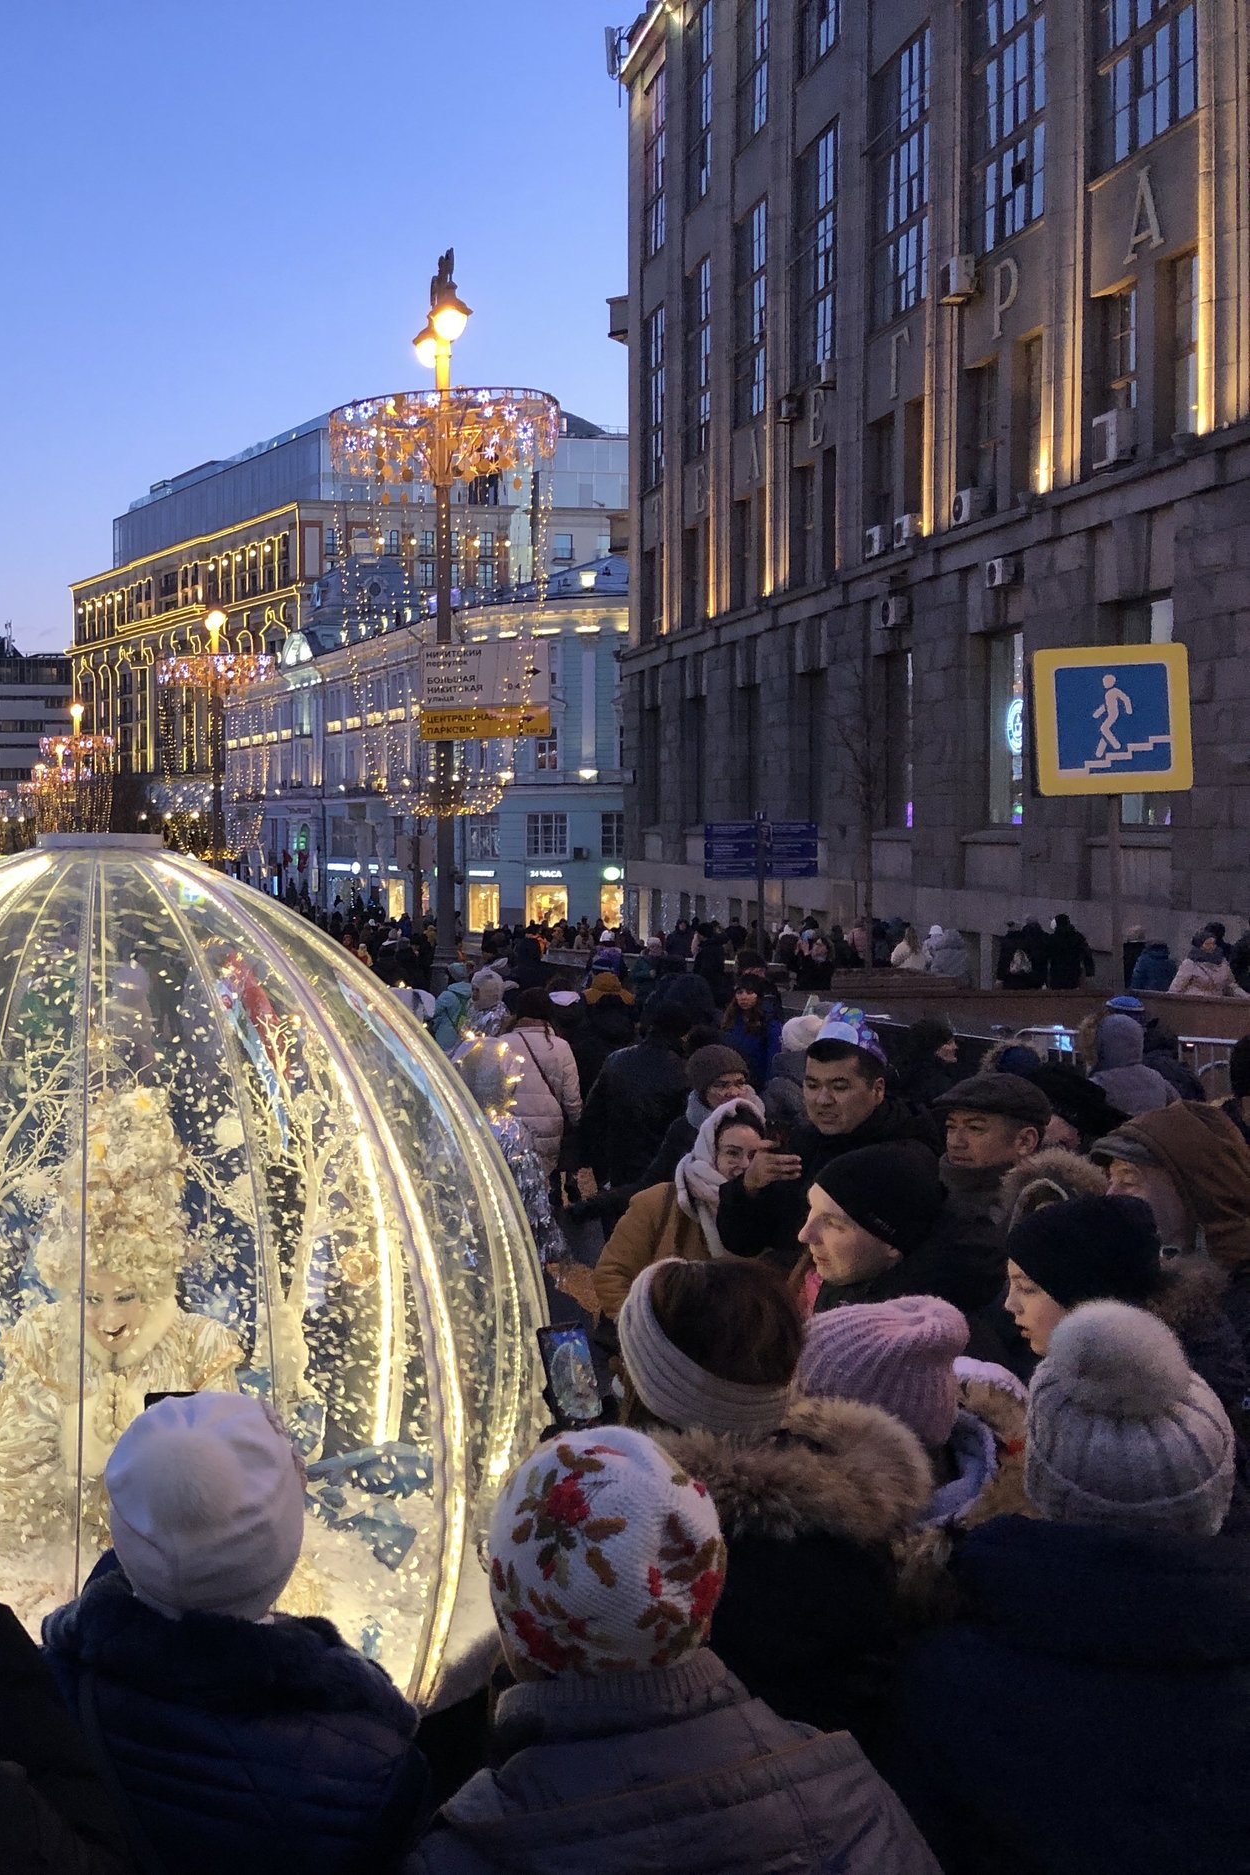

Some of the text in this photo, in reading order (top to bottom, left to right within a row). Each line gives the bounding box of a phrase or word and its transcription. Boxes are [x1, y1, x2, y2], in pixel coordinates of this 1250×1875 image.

[427, 675, 476, 685] БОЛЬШАЯ
[427, 684, 483, 694] НИКИТСКАЯ
[426, 725, 478, 735] ПАРКОВКА
[539, 869, 563, 878] ЧАСА
